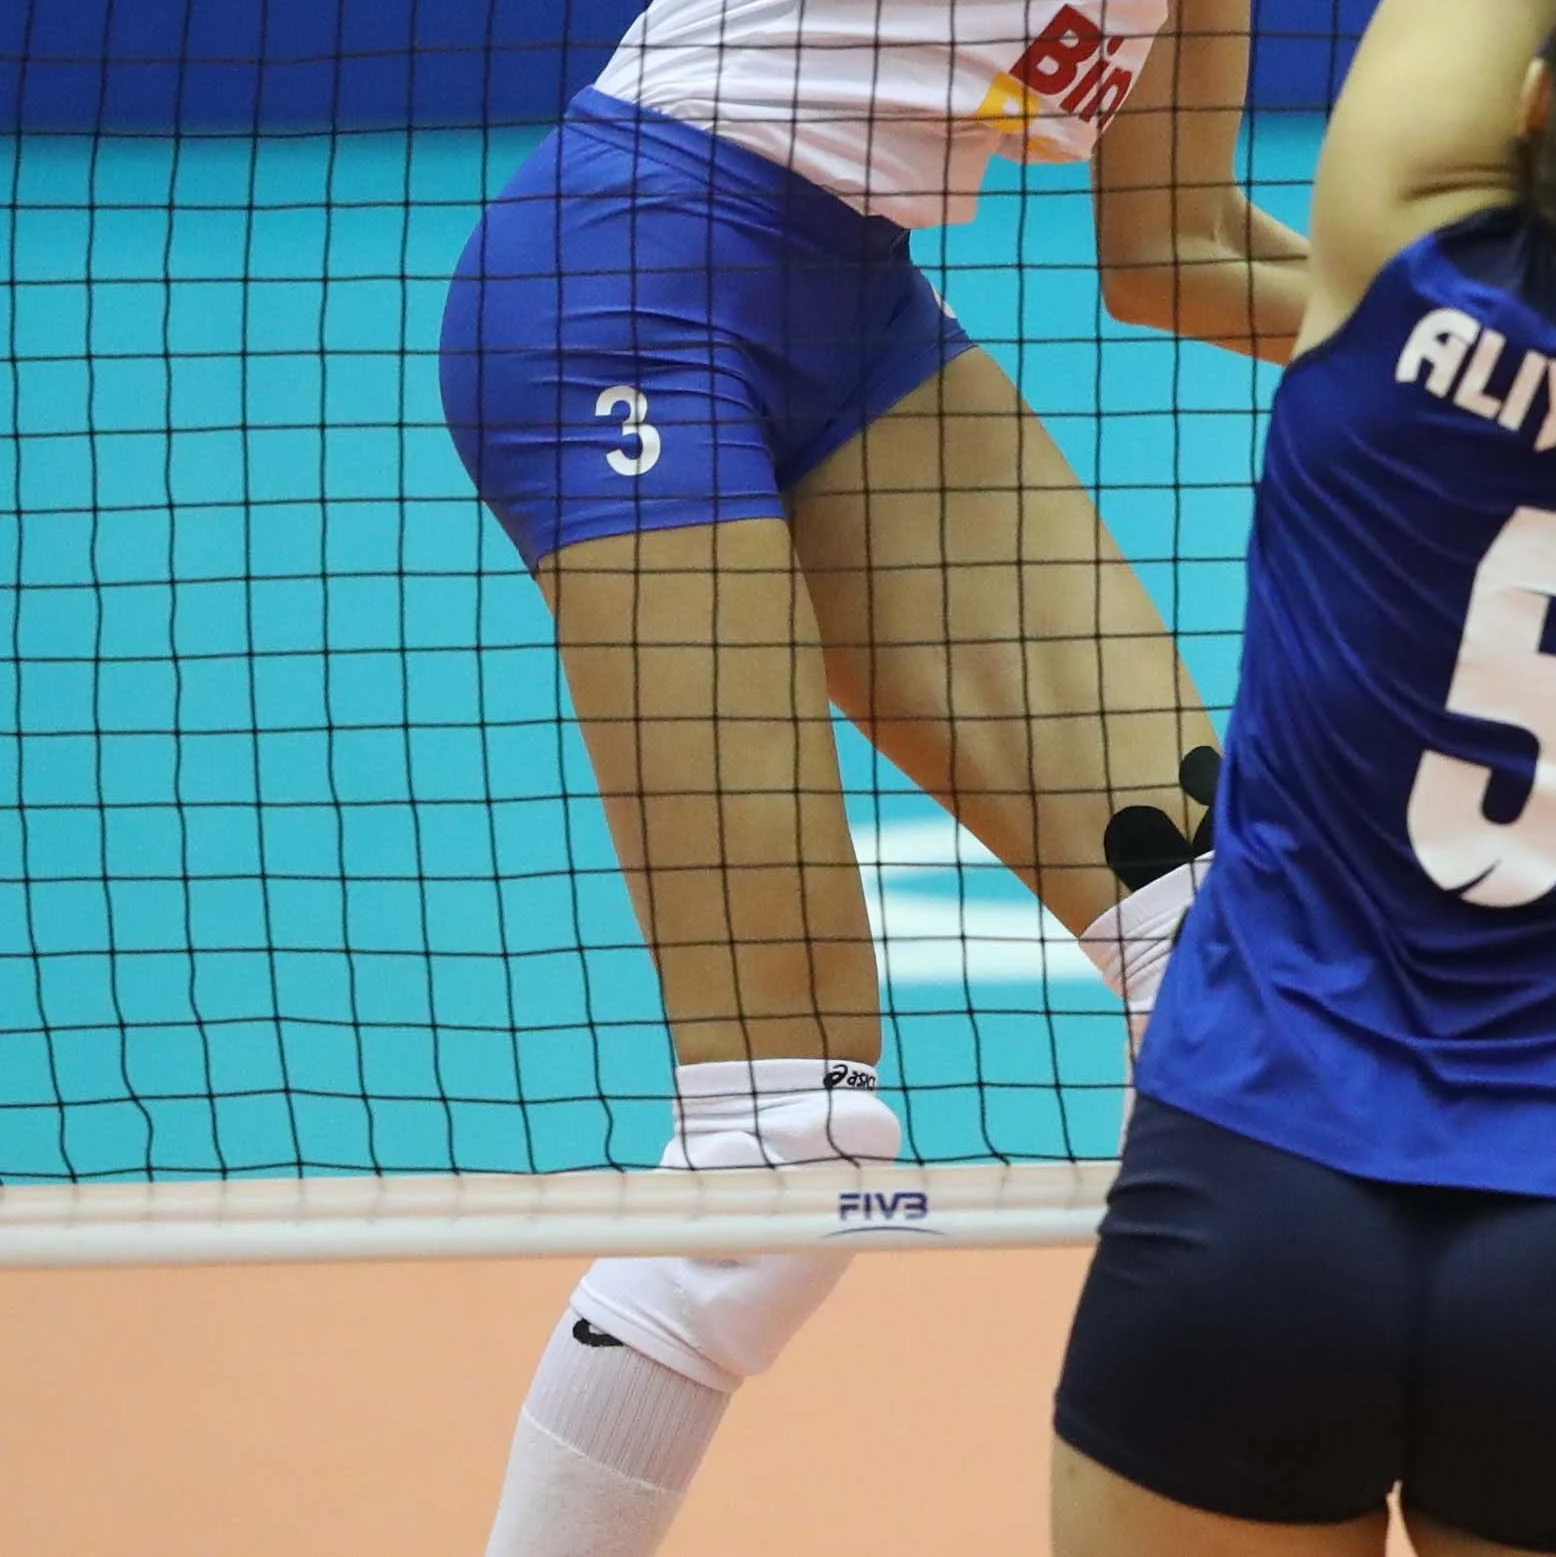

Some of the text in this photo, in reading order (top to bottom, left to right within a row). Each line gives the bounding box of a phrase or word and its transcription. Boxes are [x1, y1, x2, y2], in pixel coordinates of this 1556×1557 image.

[1008, 4, 1133, 130] Bin
[594, 385, 661, 477] 3
[839, 1192, 929, 1221] FIVB
